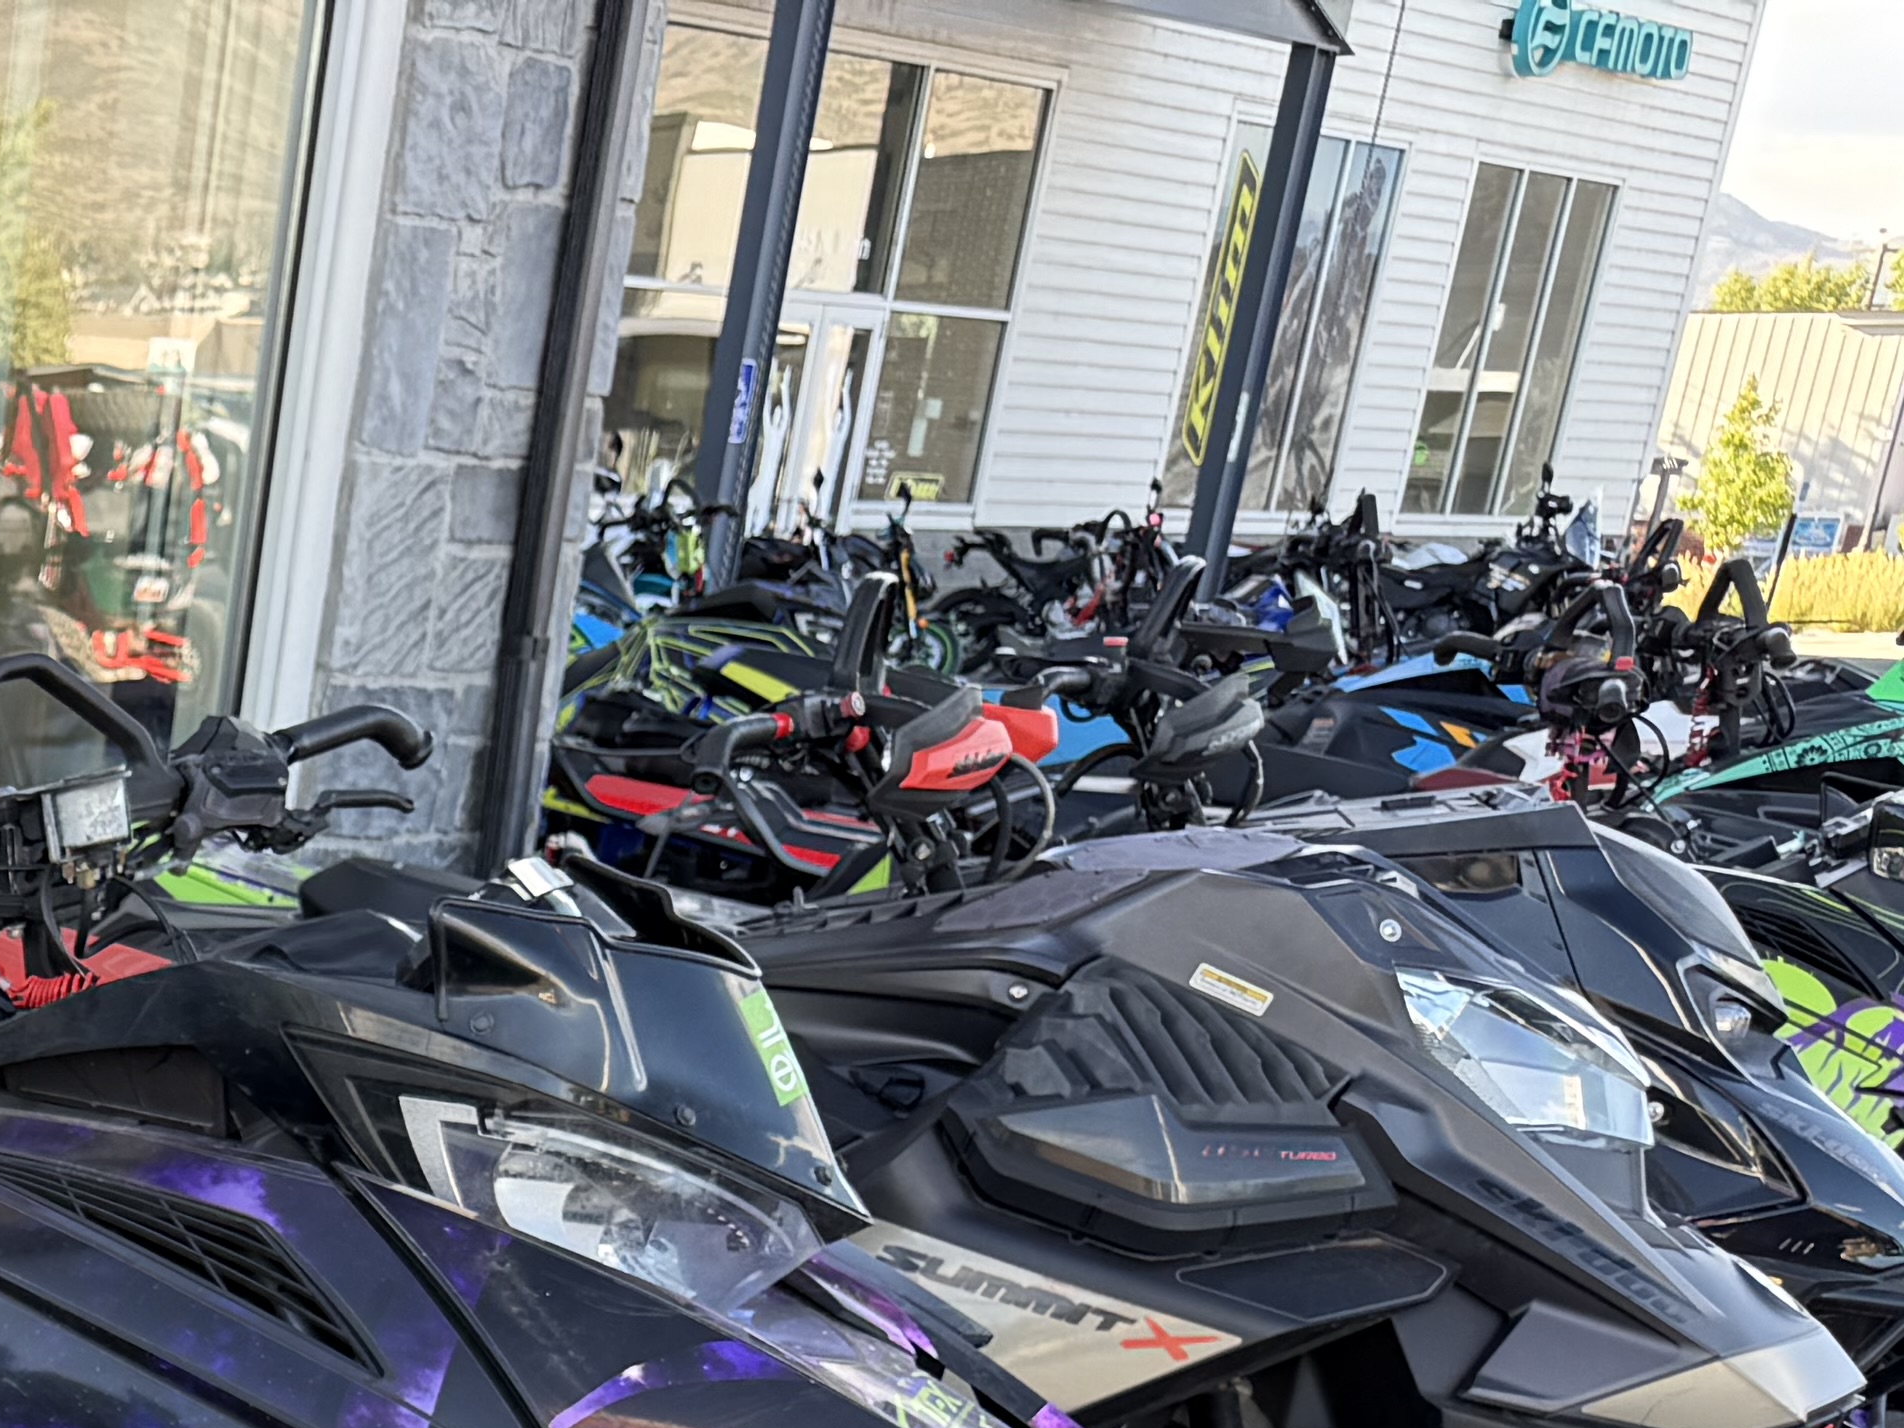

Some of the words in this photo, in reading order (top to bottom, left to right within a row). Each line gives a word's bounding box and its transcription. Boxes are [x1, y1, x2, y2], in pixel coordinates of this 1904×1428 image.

[1575, 11, 1692, 80] CFMOTO
[876, 1244, 1137, 1332] SUMMIT
[1120, 1316, 1223, 1363] X
